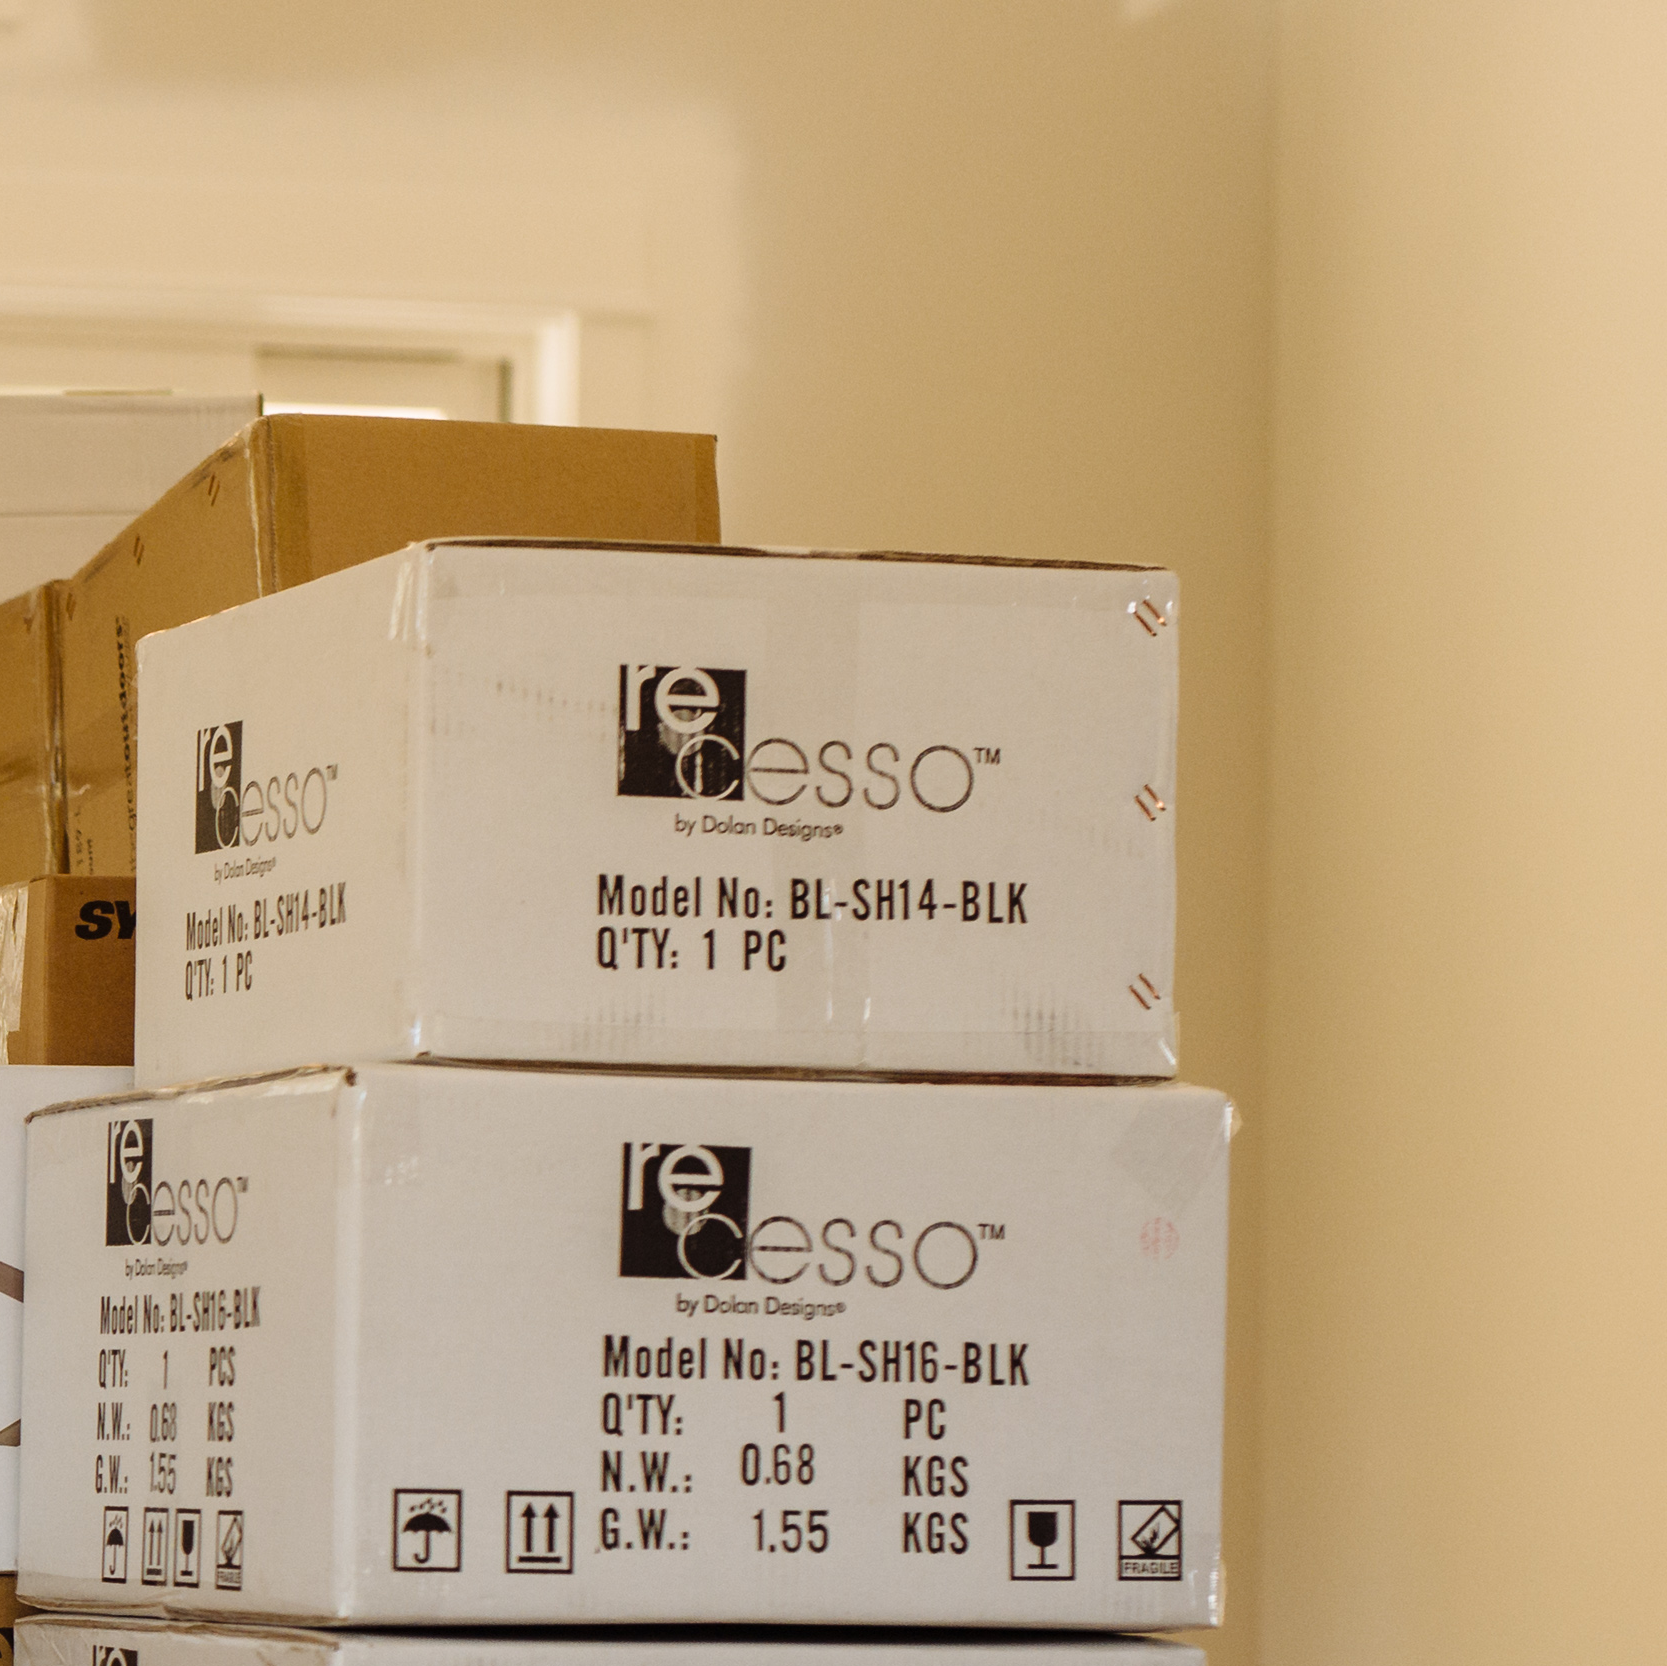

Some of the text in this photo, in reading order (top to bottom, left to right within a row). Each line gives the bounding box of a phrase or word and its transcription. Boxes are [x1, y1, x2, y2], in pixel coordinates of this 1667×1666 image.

[674, 813, 696, 837] by
[701, 814, 756, 836] Dolan
[213, 863, 223, 884] by
[224, 860, 244, 880] Dolan
[186, 881, 347, 950] Model No: BL-SH14-BLK
[597, 874, 1029, 924] Model No: BL-SH14-BLK
[596, 927, 787, 972] Q'TY: 1 PC
[185, 950, 253, 1001] Q'TY: 1 PC
[100, 1286, 261, 1334] Model No: BL-SH16-BLK
[676, 1293, 697, 1316] by
[703, 1295, 758, 1315] Dolan
[98, 1346, 235, 1390] Q'TY: 1 PCS
[603, 1335, 1031, 1386] Model No: BL-SH16-BLK
[97, 1401, 235, 1442] N.W.: 0.68 KGS
[602, 1392, 947, 1439] Q'TY: 1 PC
[95, 1452, 233, 1498] G.W.: 1.55 KGS
[600, 1442, 970, 1497] N.W.: 0.68 KGS
[599, 1508, 970, 1554] G.W.: 1.55 KGS
[1123, 1561, 1180, 1576] FRAGILE
